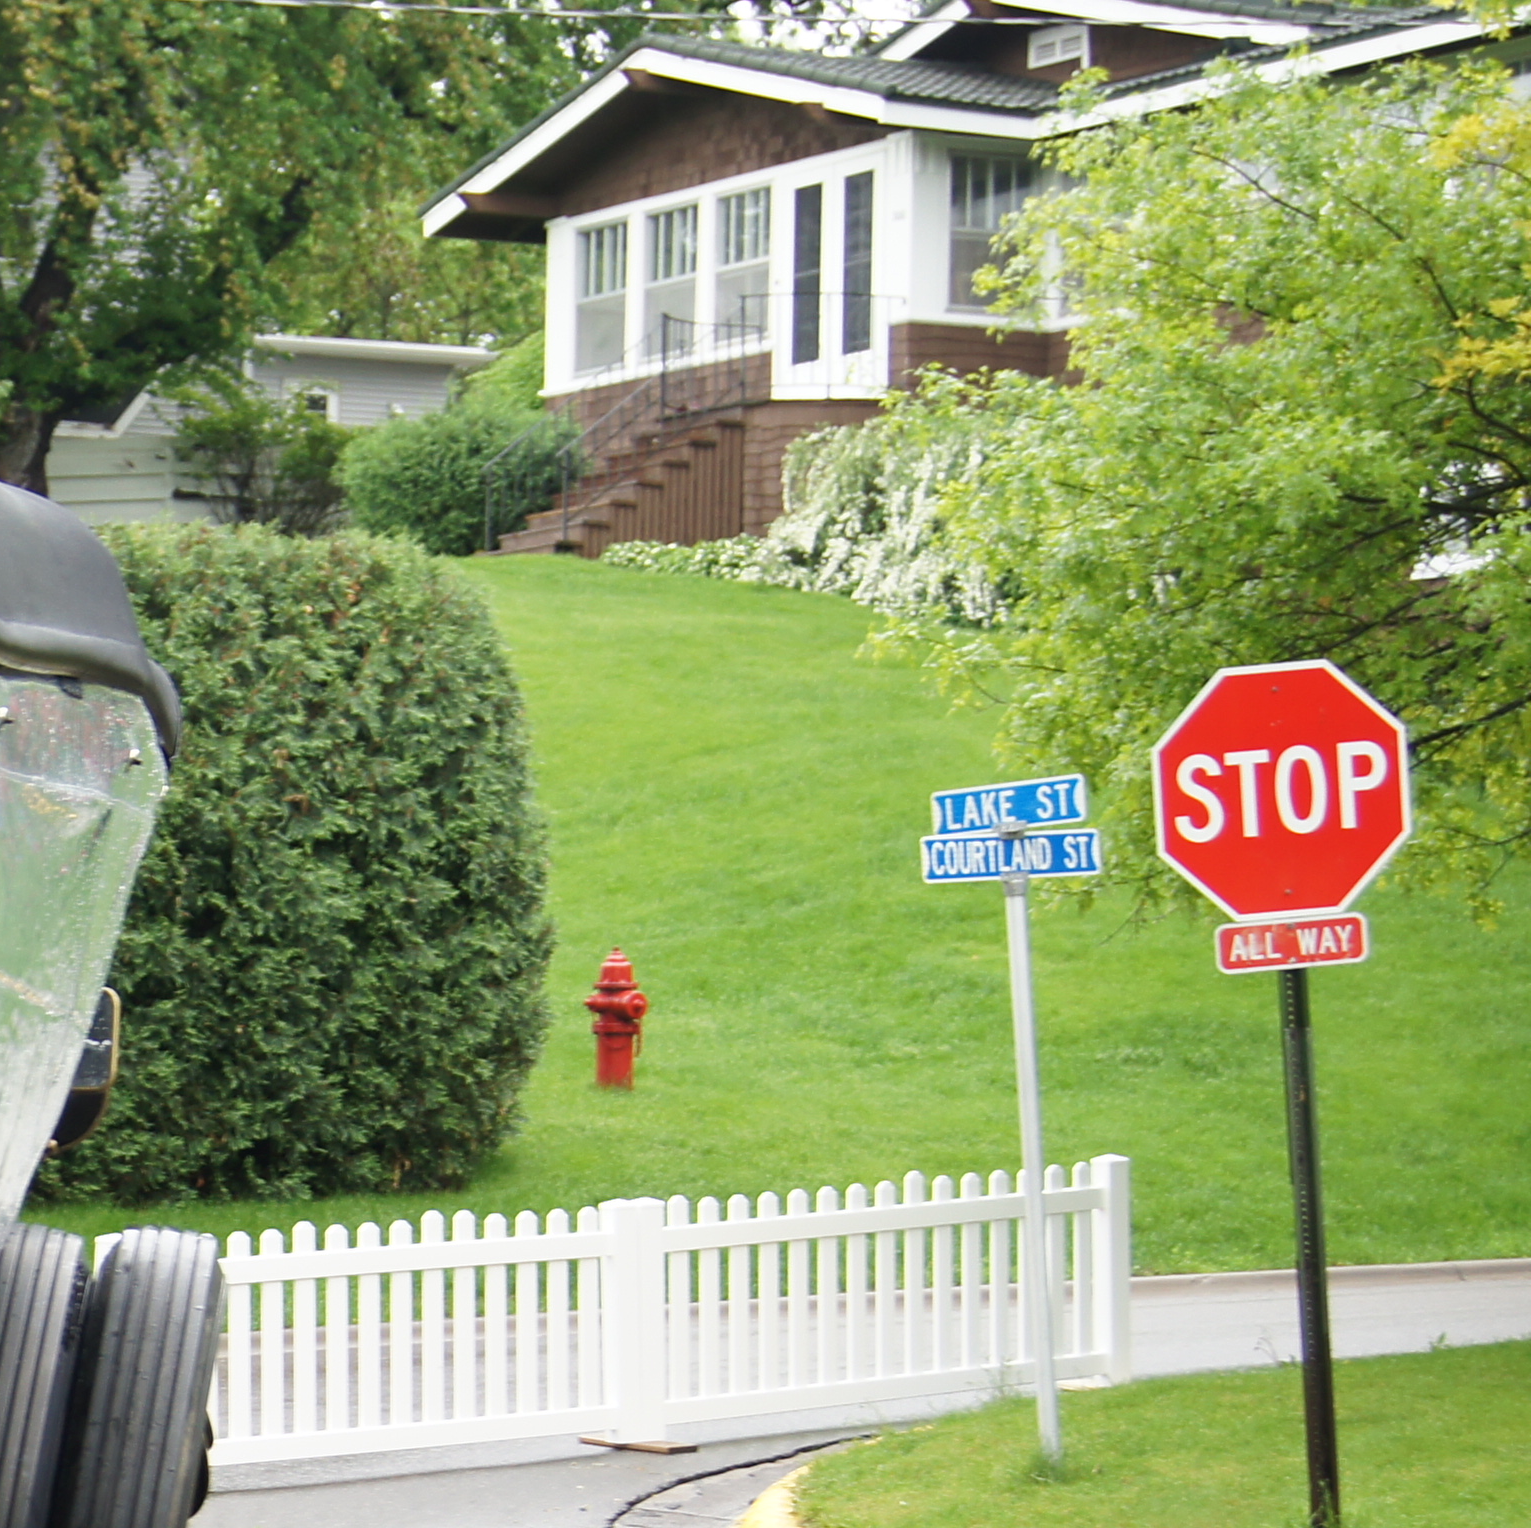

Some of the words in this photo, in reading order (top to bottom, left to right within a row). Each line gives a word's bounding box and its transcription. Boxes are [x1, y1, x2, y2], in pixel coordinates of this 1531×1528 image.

[945, 789, 1017, 830] LAKE
[1036, 783, 1070, 820] ST
[1175, 740, 1388, 843] STOP
[930, 838, 1051, 876] COURTLAND
[1063, 834, 1091, 869] ST
[1229, 933, 1282, 963] ALL
[1296, 924, 1354, 954] WAY
